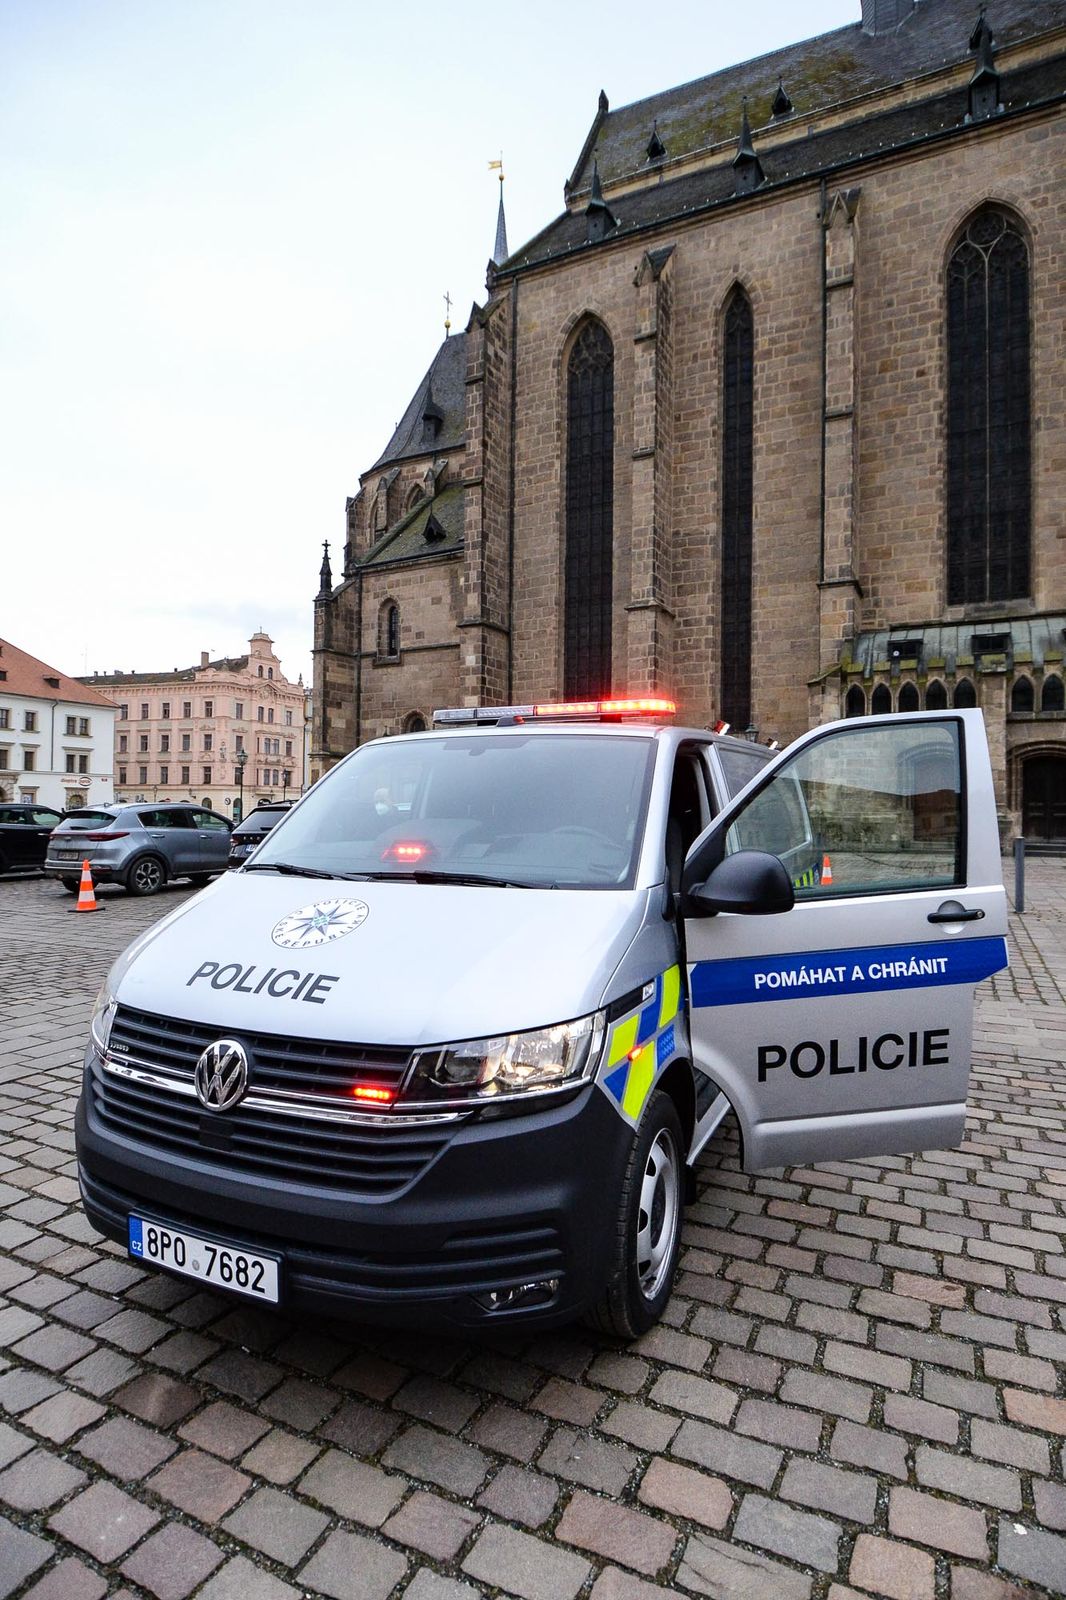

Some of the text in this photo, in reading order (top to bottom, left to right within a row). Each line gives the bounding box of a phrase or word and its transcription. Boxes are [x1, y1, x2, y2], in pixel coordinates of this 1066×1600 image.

[186, 961, 340, 1004] POLICIE
[754, 956, 948, 989] POMÁHAT A CHRÁNIT
[757, 1028, 950, 1083] POLICIE
[131, 1240, 142, 1251] CZ
[204, 1245, 266, 1294] 7682
